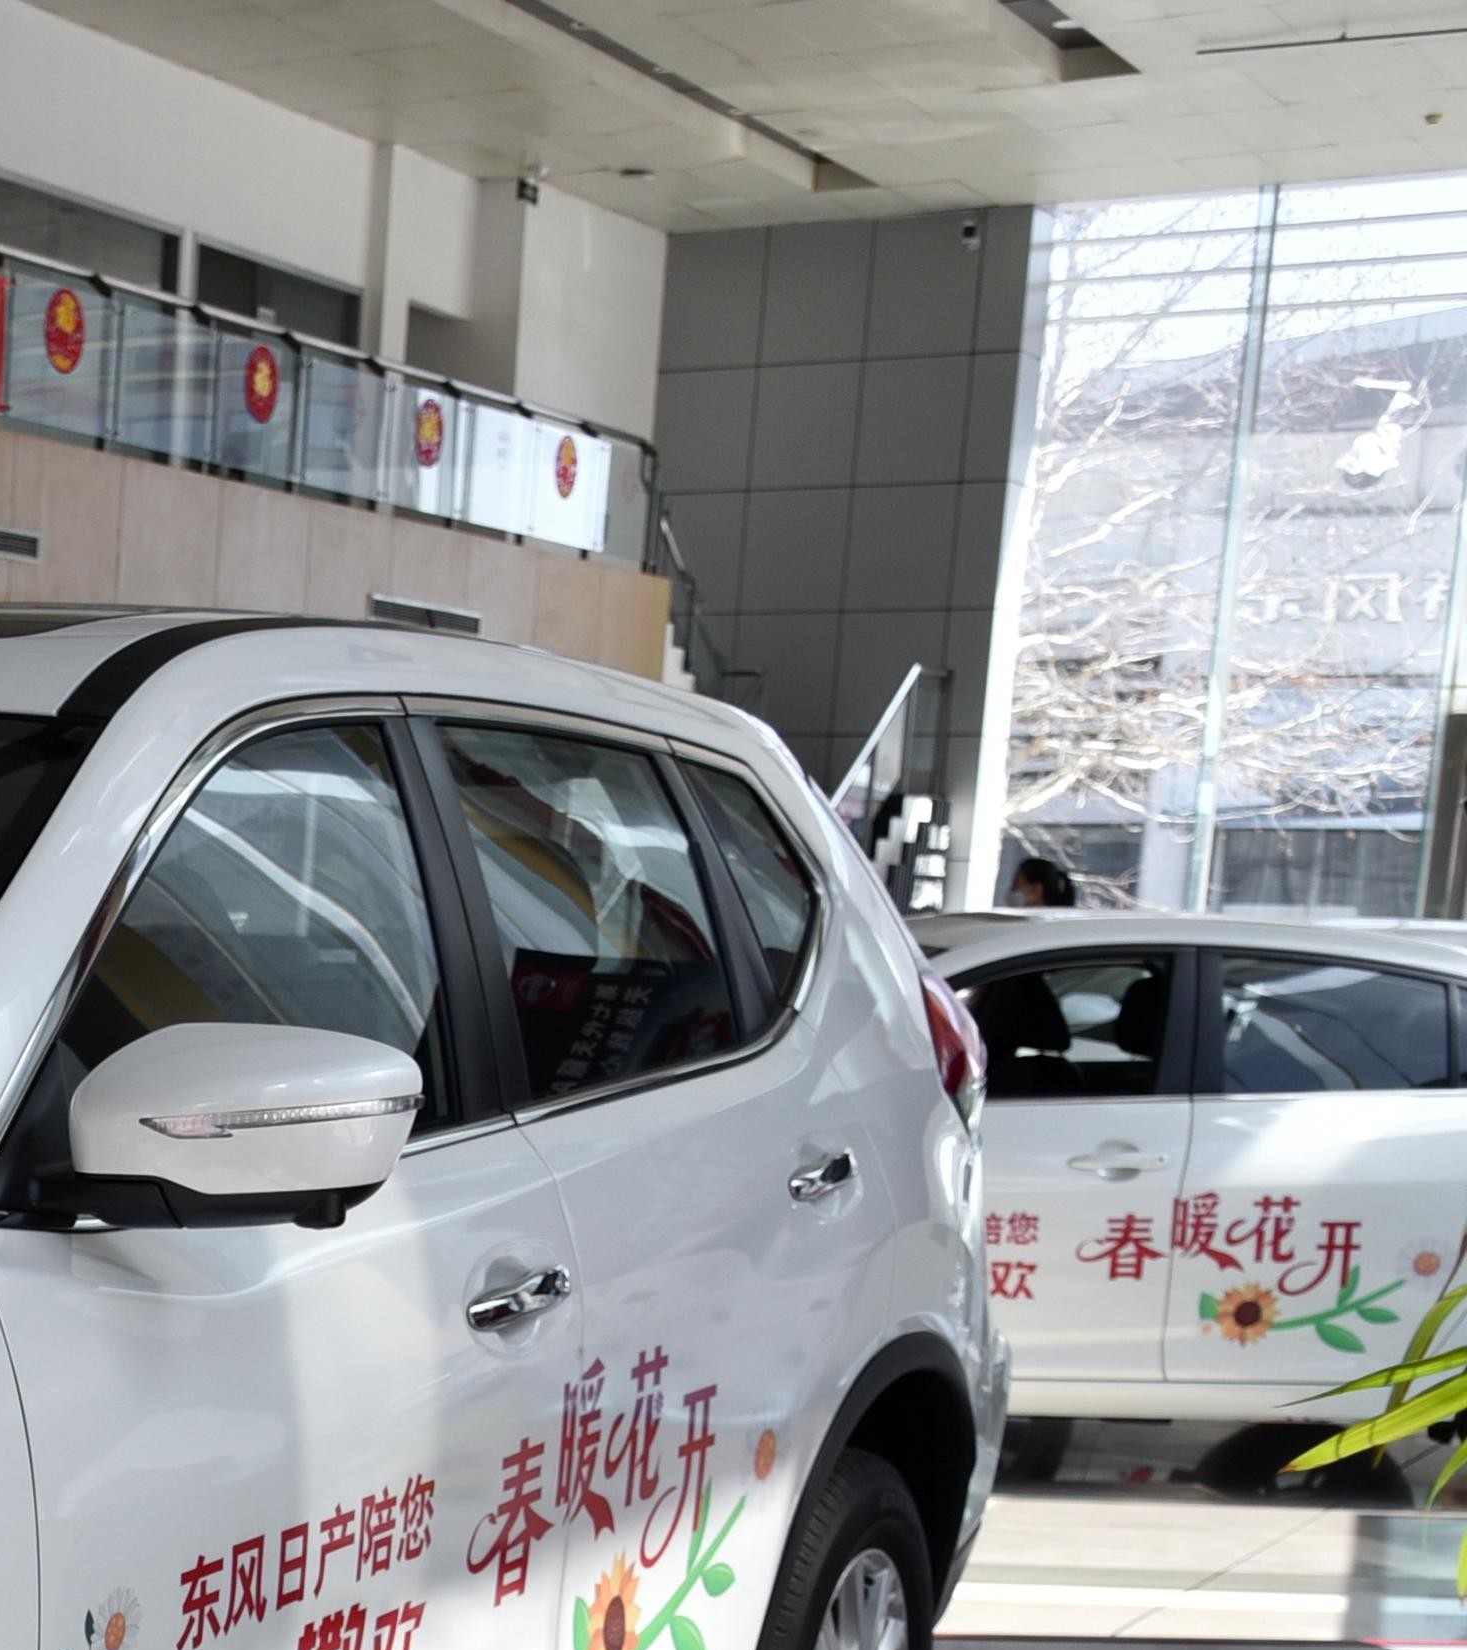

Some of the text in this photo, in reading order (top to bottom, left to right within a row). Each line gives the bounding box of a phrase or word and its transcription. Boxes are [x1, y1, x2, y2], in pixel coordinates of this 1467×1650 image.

[990, 1261, 1037, 1300] 欢
[1076, 1192, 1362, 1297] 春暖花开
[466, 1345, 719, 1608] 春暖花开
